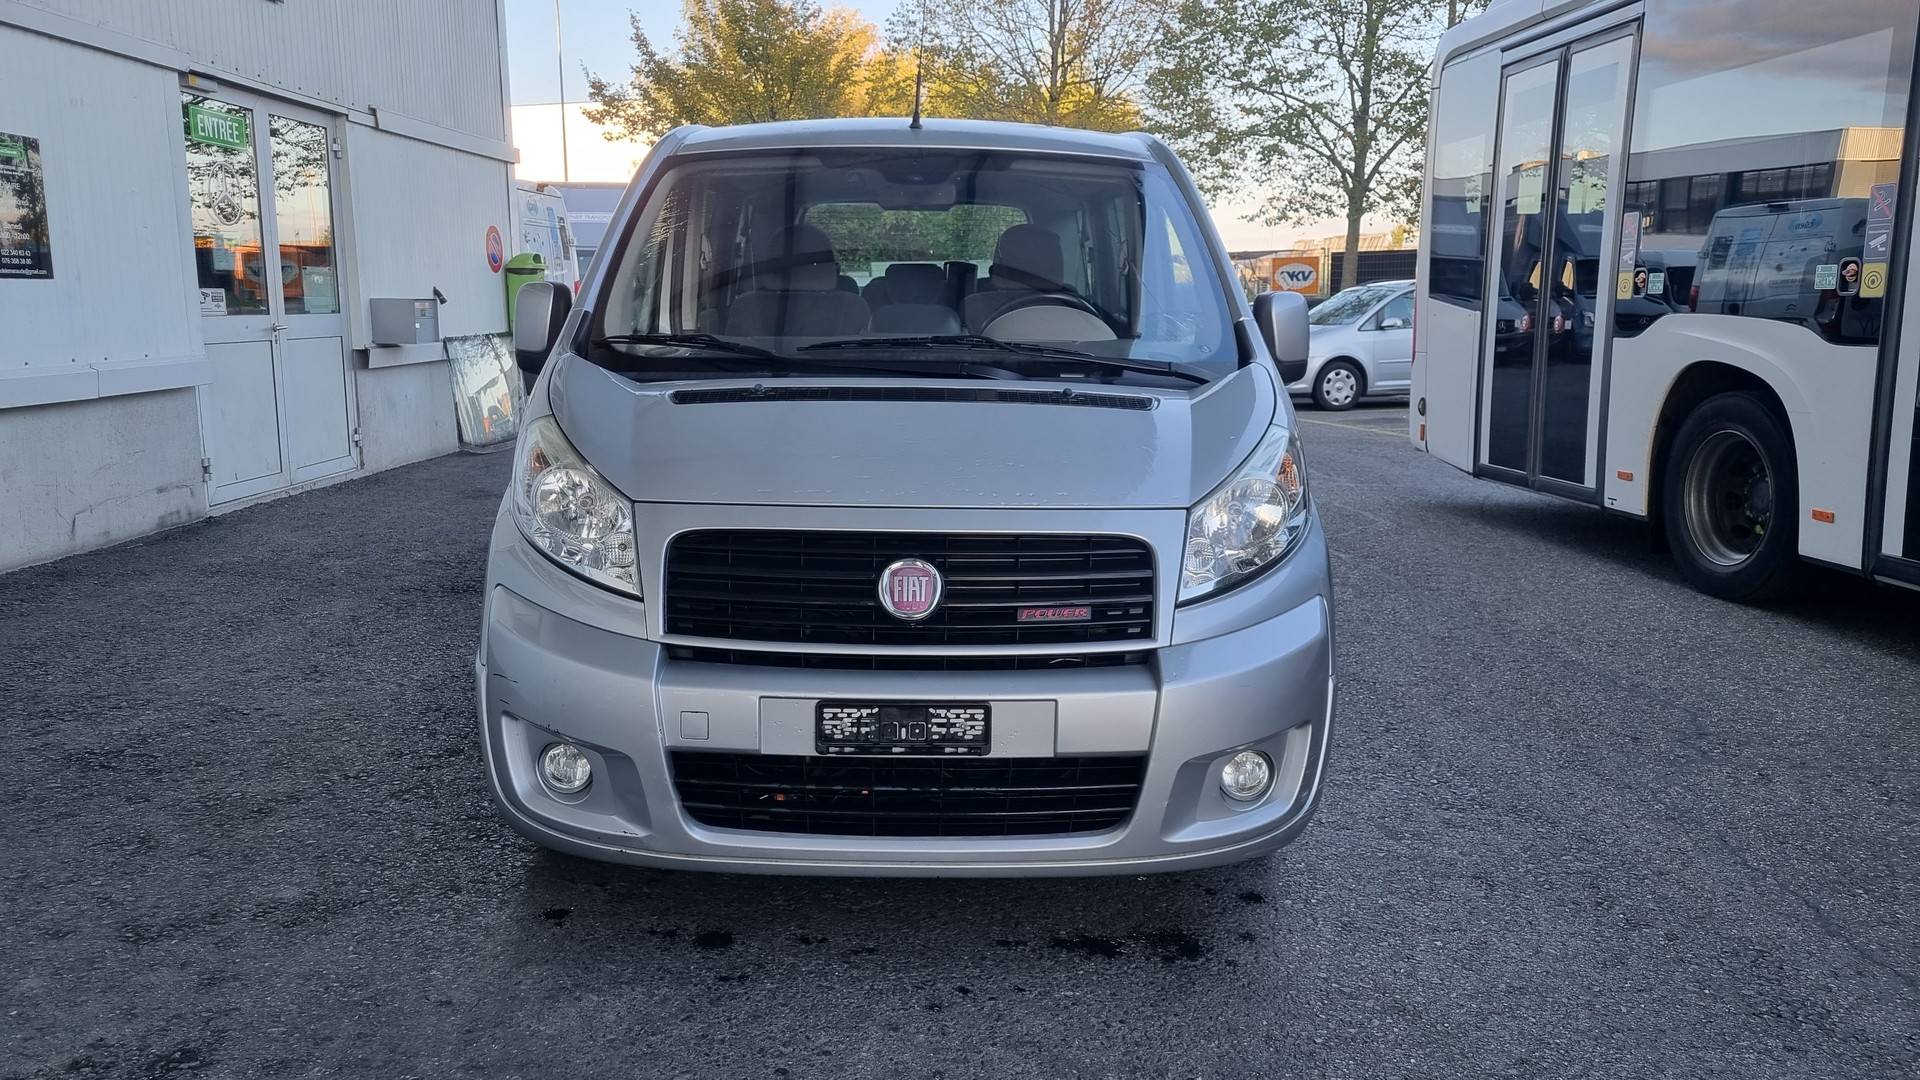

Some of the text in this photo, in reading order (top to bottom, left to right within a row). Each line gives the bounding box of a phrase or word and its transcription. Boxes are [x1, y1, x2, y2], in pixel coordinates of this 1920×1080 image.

[197, 113, 240, 144] ENTRÉE
[893, 576, 929, 602] FIAT
[1020, 608, 1088, 619] POWER
